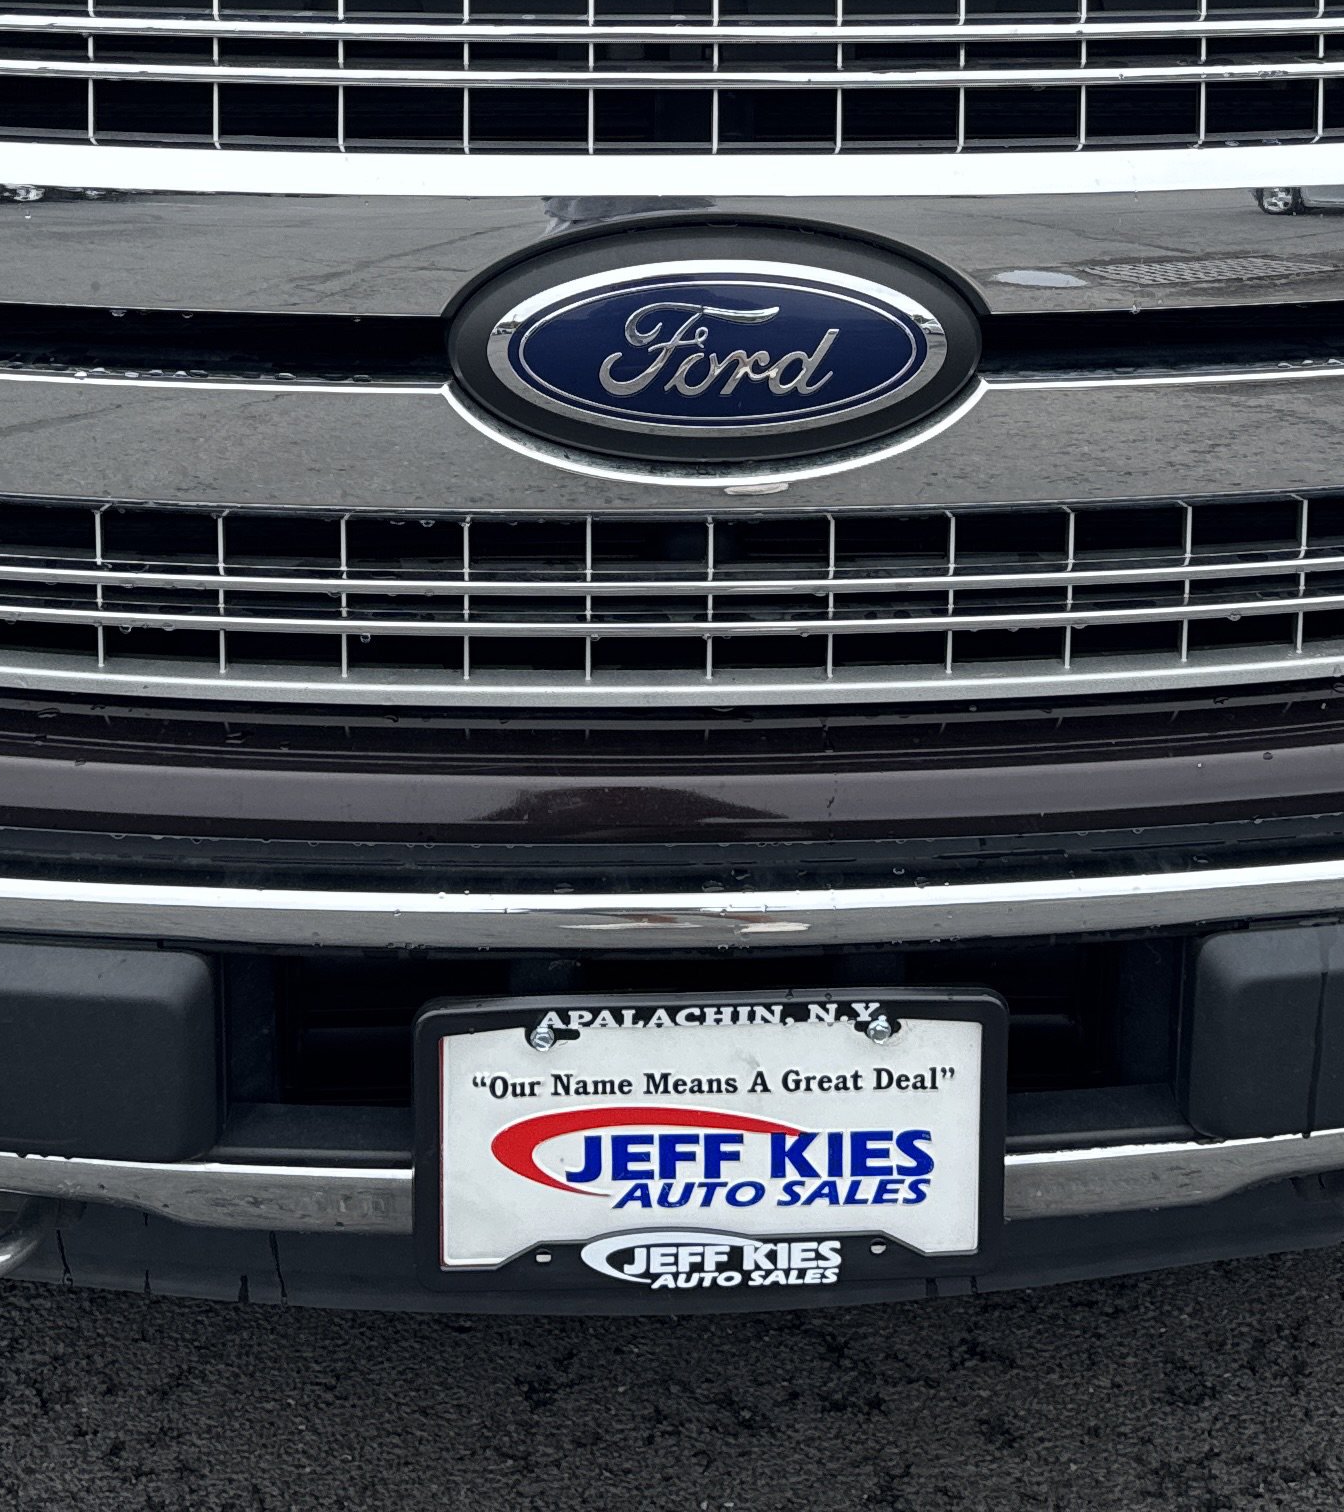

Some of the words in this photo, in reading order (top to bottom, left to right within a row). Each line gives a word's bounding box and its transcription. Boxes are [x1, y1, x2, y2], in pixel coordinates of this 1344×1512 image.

[599, 302, 840, 396] Ford
[538, 1005, 795, 1029] APALACHIN,
[550, 1073, 634, 1096] Name
[643, 1072, 739, 1095] Means
[747, 1070, 772, 1094] A
[781, 1068, 864, 1093] Great
[565, 1133, 744, 1184] JEFF
[770, 1129, 935, 1179] KIES
[611, 1180, 766, 1210] AUTO
[776, 1178, 932, 1206] SALES
[623, 1244, 731, 1276] JEFF
[742, 1240, 842, 1271] KIES
[650, 1269, 744, 1289] AUTO
[748, 1267, 840, 1287] SALES
